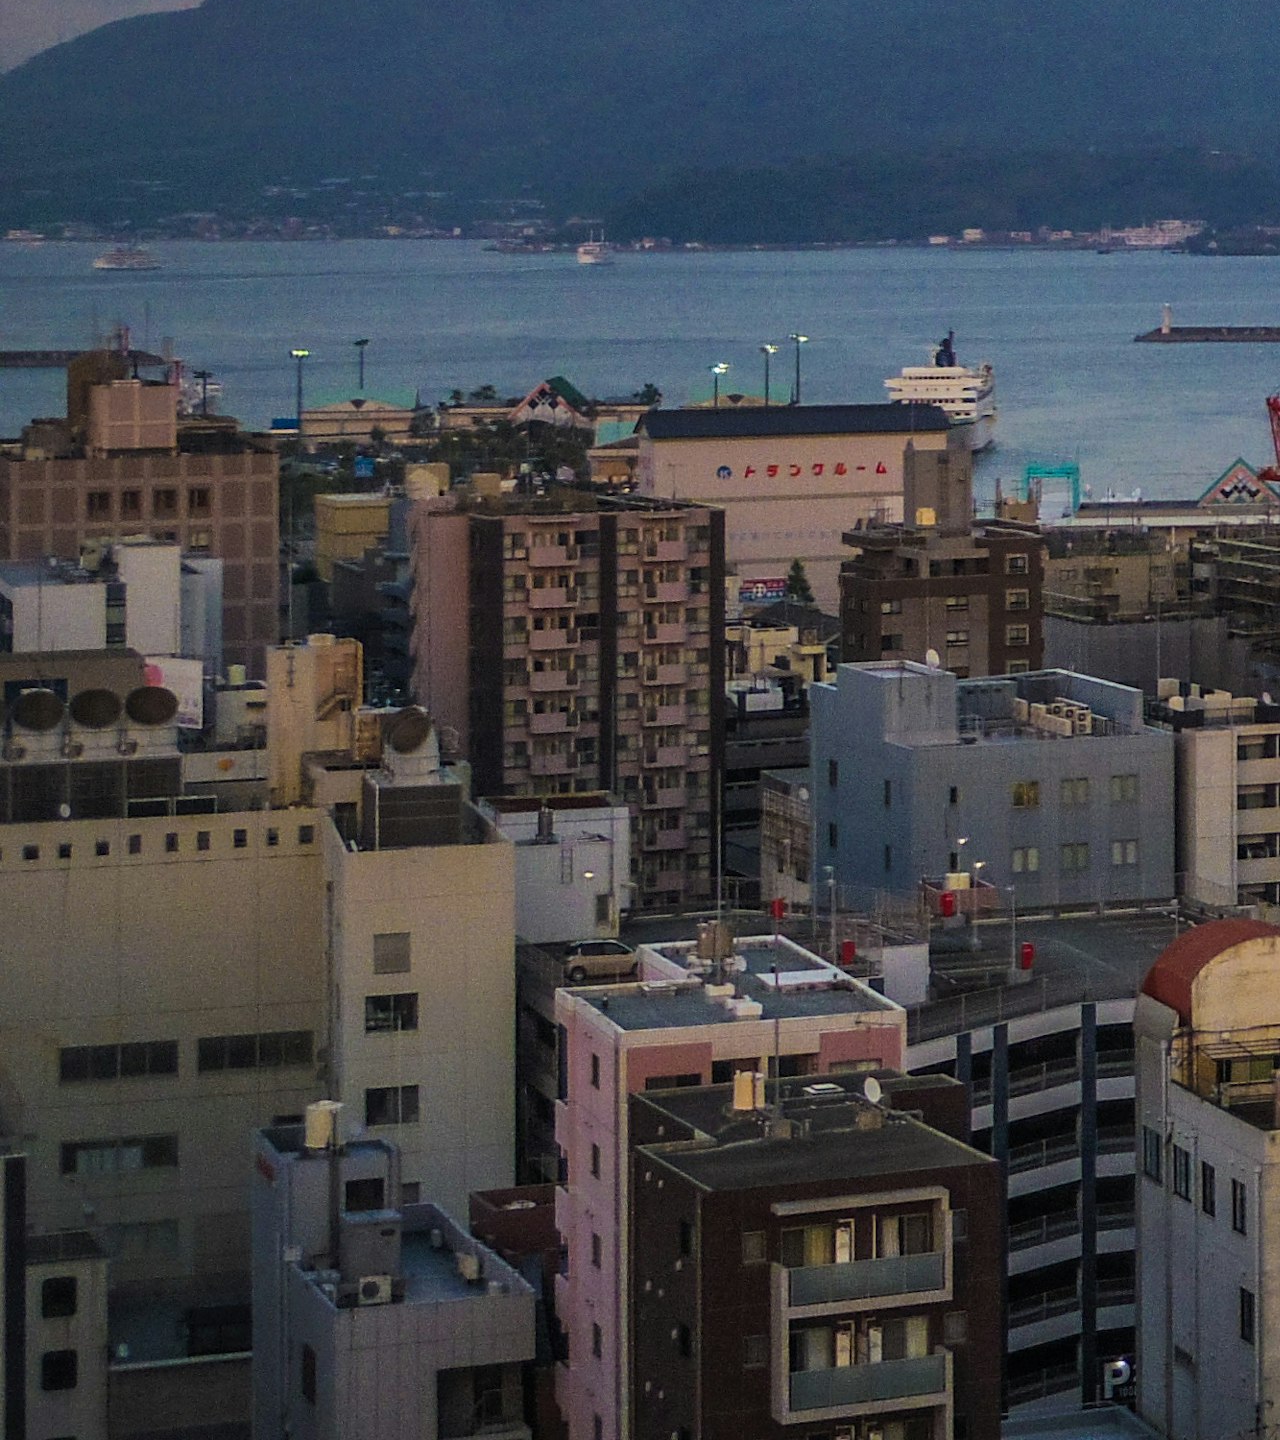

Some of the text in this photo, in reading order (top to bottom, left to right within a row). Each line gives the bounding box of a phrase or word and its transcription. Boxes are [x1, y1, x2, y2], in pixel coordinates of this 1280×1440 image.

[744, 461, 887, 478] トランクルーム
[1104, 1360, 1131, 1399] P
